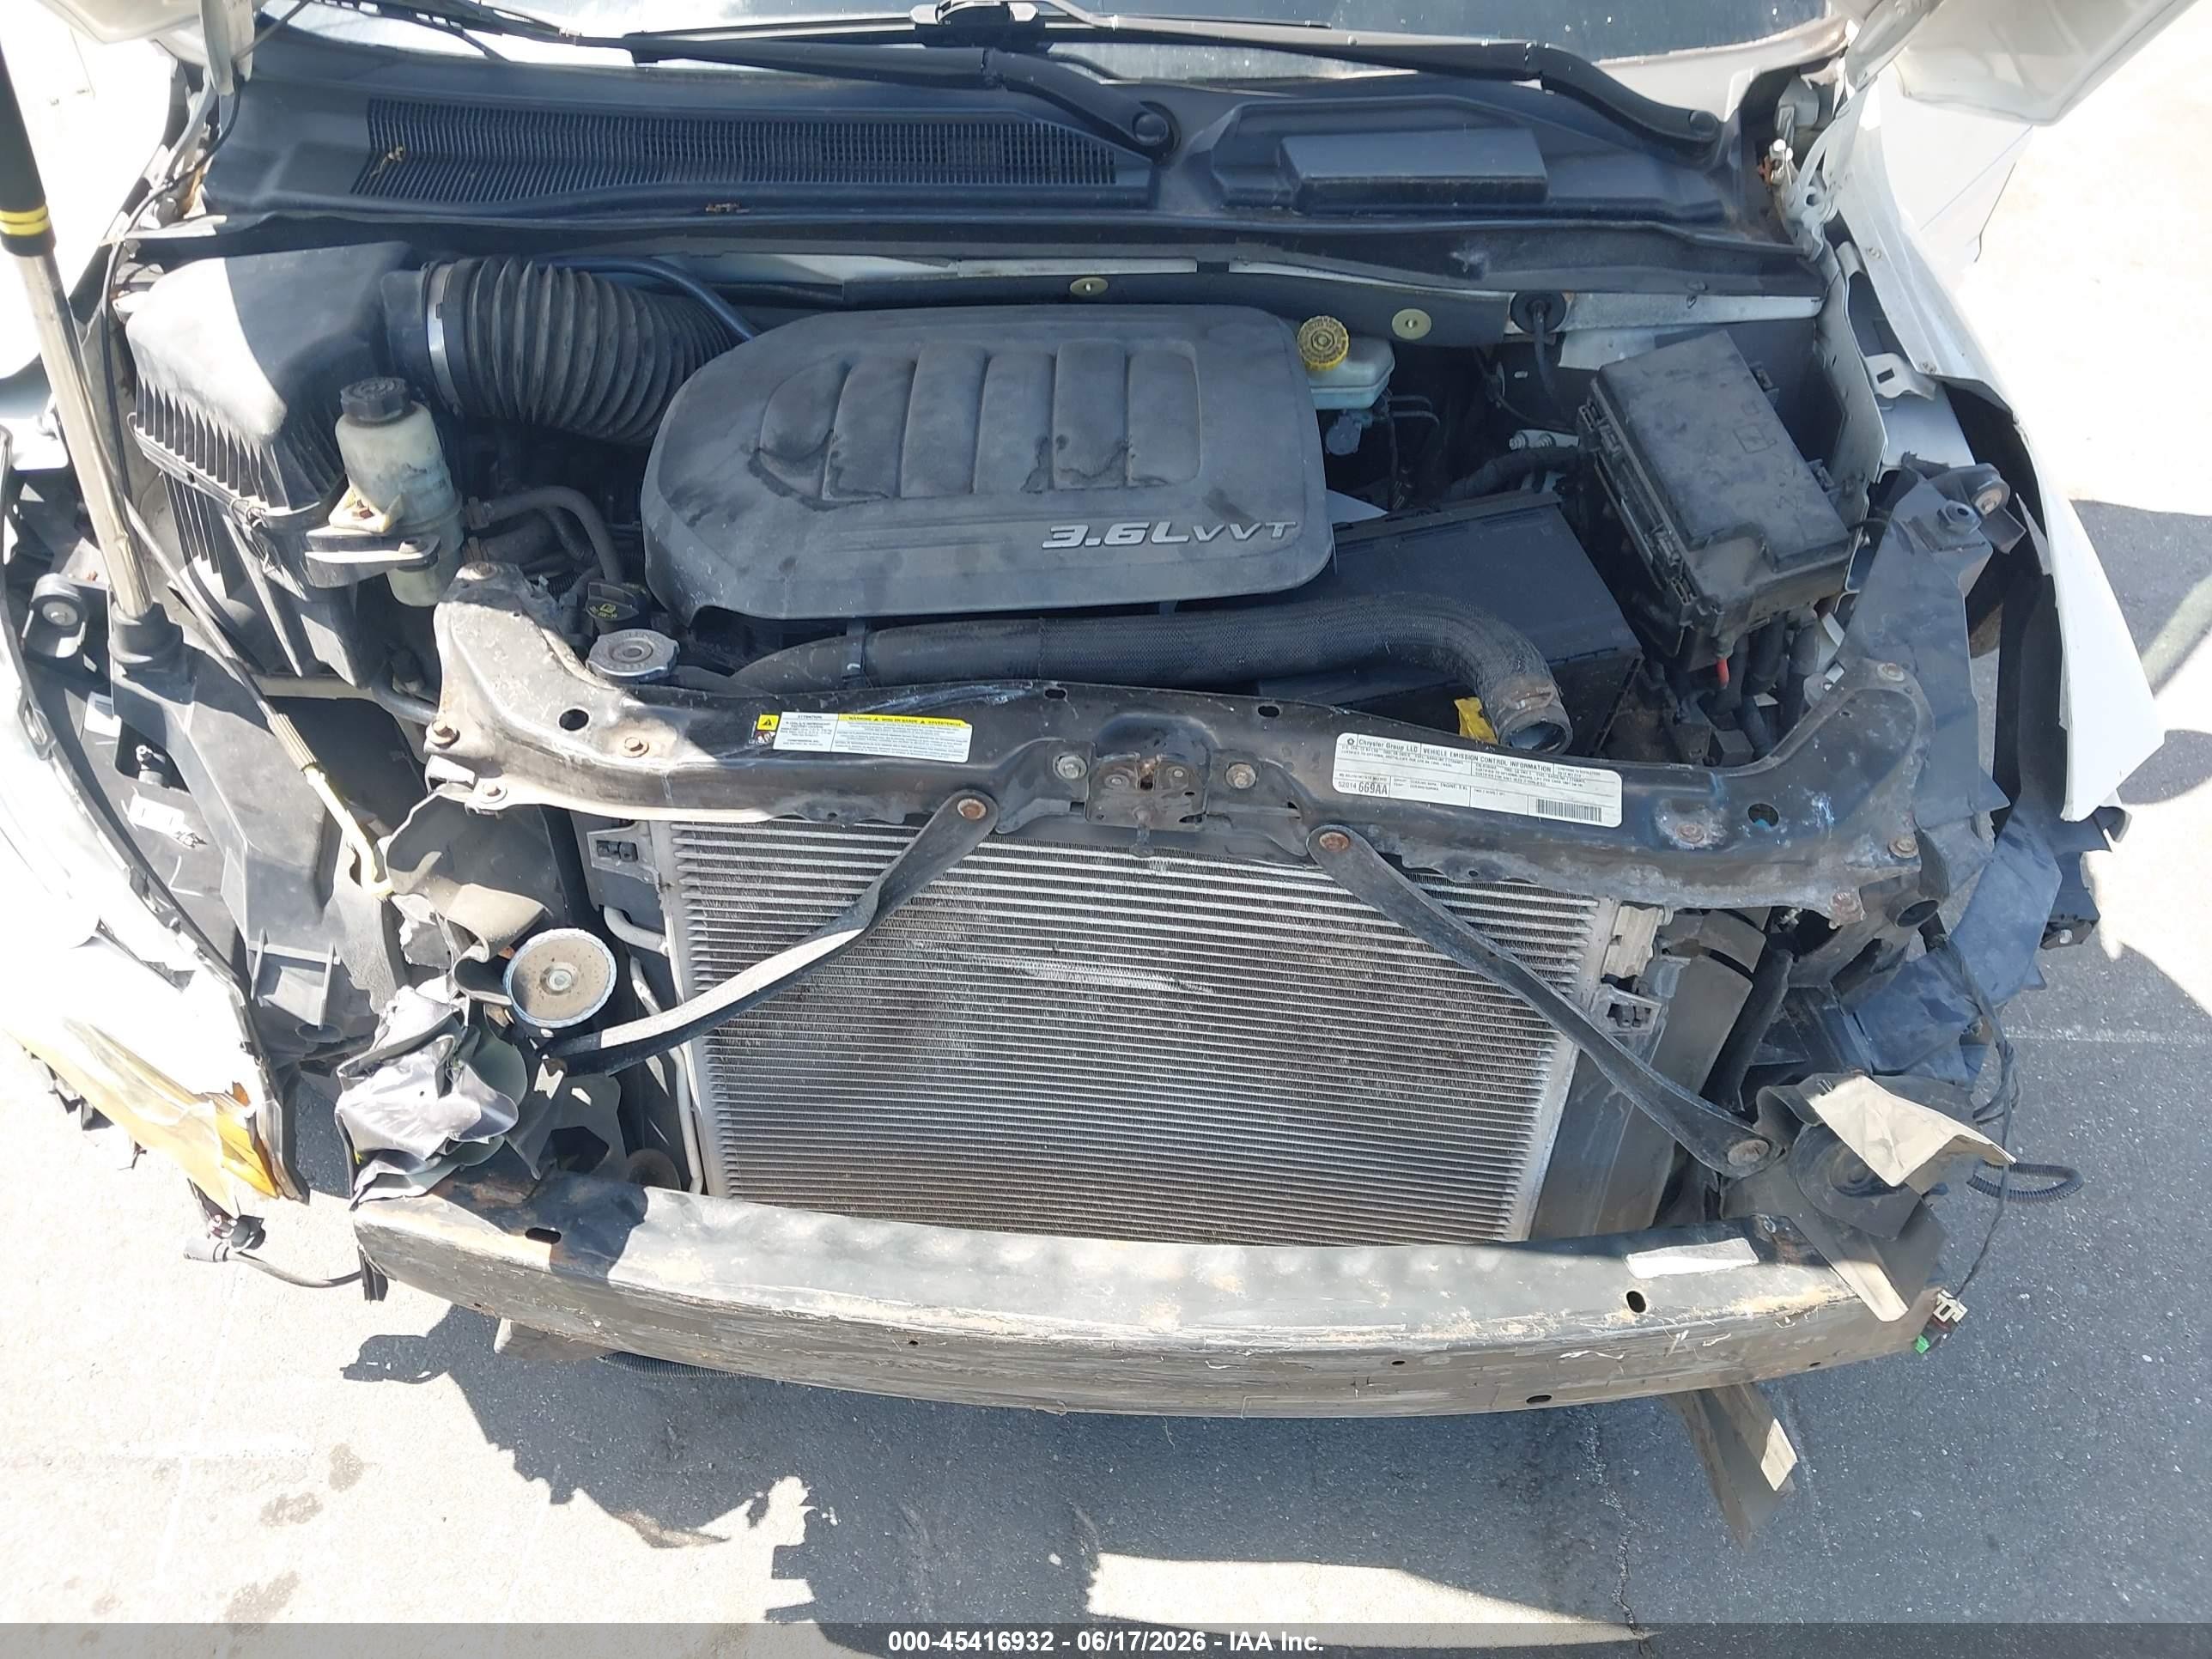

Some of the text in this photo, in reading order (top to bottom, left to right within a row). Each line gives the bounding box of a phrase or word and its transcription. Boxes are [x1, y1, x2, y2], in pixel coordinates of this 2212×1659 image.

[1358, 738, 1384, 748] Chrysler
[1386, 742, 1405, 751] Group
[1423, 748, 1448, 757] VEHICLE
[1449, 751, 1479, 761] EMISSION
[1480, 756, 1508, 765] CONTROL
[1510, 759, 1552, 772] INFORMATION
[1358, 781, 1388, 795] 669AA
